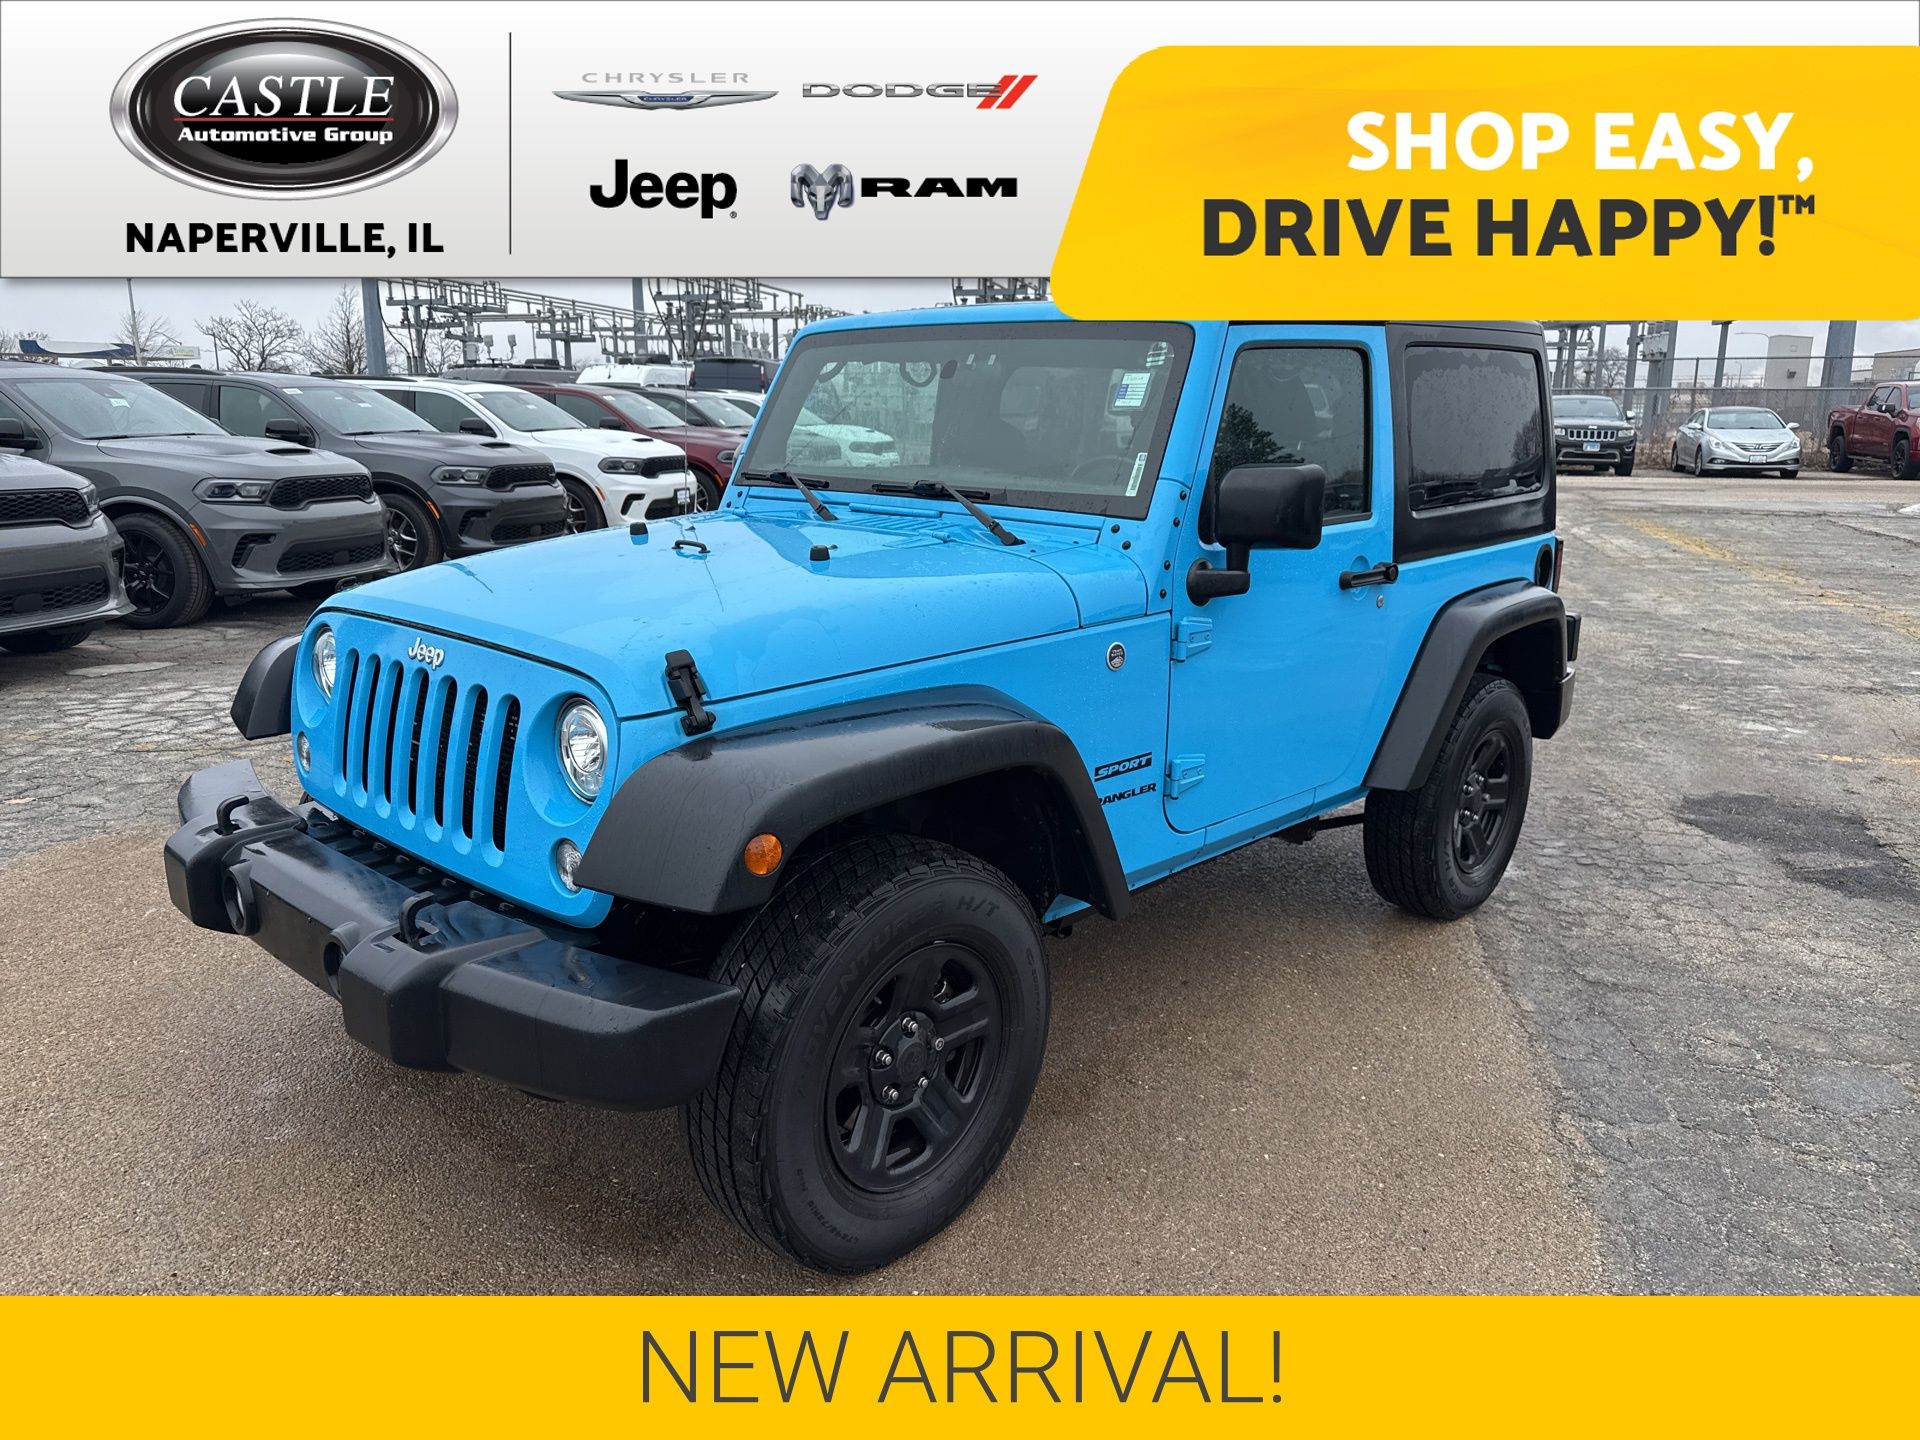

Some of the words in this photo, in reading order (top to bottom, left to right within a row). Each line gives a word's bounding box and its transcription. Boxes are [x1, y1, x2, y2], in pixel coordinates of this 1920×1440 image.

[408, 636, 444, 669] Jeep
[1096, 755, 1152, 779] SPORT
[956, 895, 1000, 918] H/T
